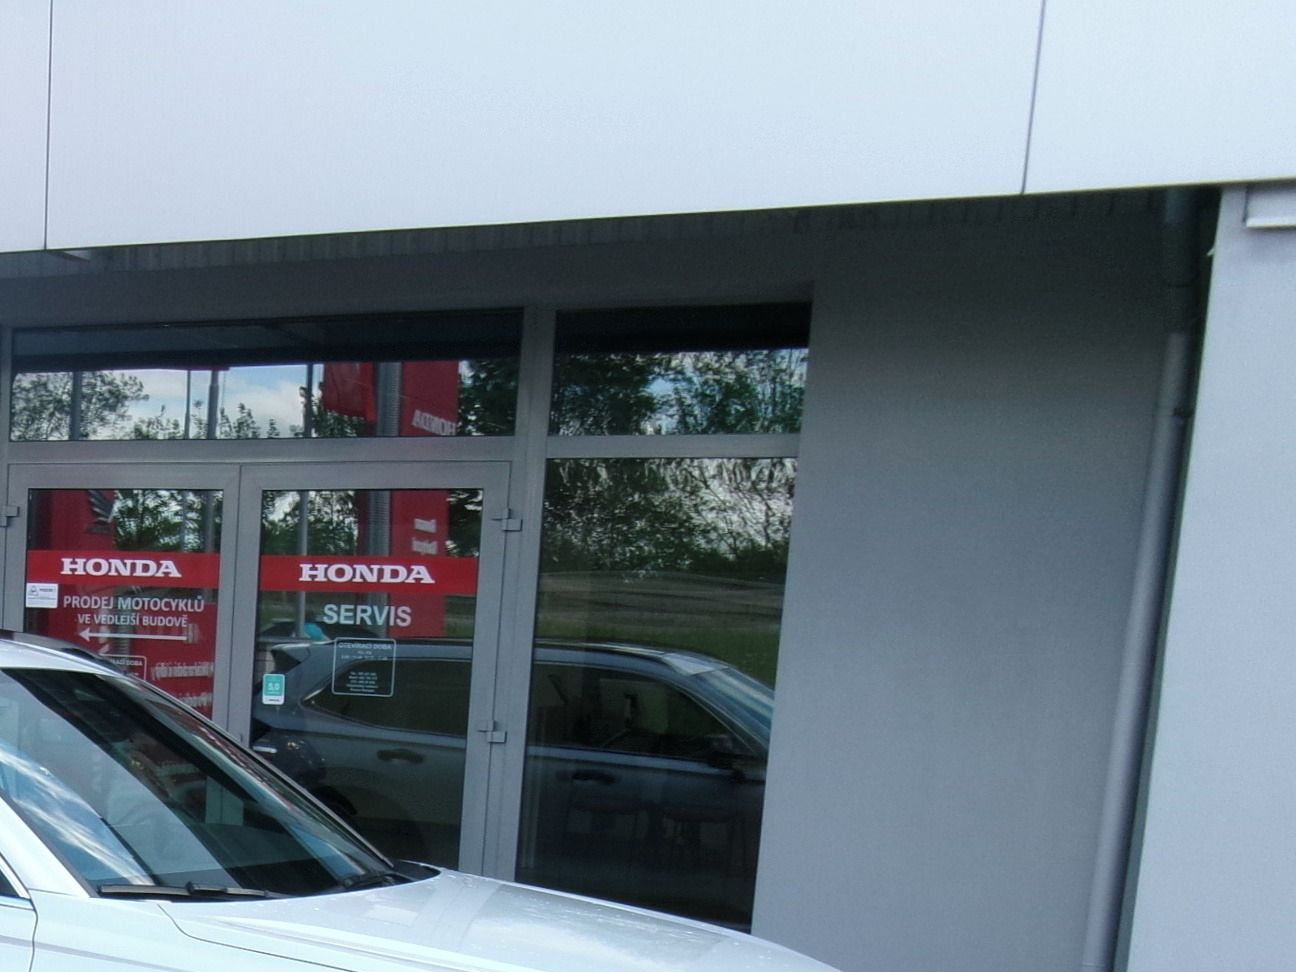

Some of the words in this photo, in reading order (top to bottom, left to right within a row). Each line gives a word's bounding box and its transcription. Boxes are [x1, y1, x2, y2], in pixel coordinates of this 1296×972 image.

[60, 558, 182, 577] HONDA
[298, 563, 435, 583] HONDA
[63, 595, 114, 609] PRODEJ
[117, 595, 204, 612] MOTOCYKLŮ
[77, 613, 91, 624] VE
[93, 612, 139, 626] VEDLEJŠÍ
[142, 615, 188, 627] BUDOVĚ
[323, 604, 412, 627] SERVIS
